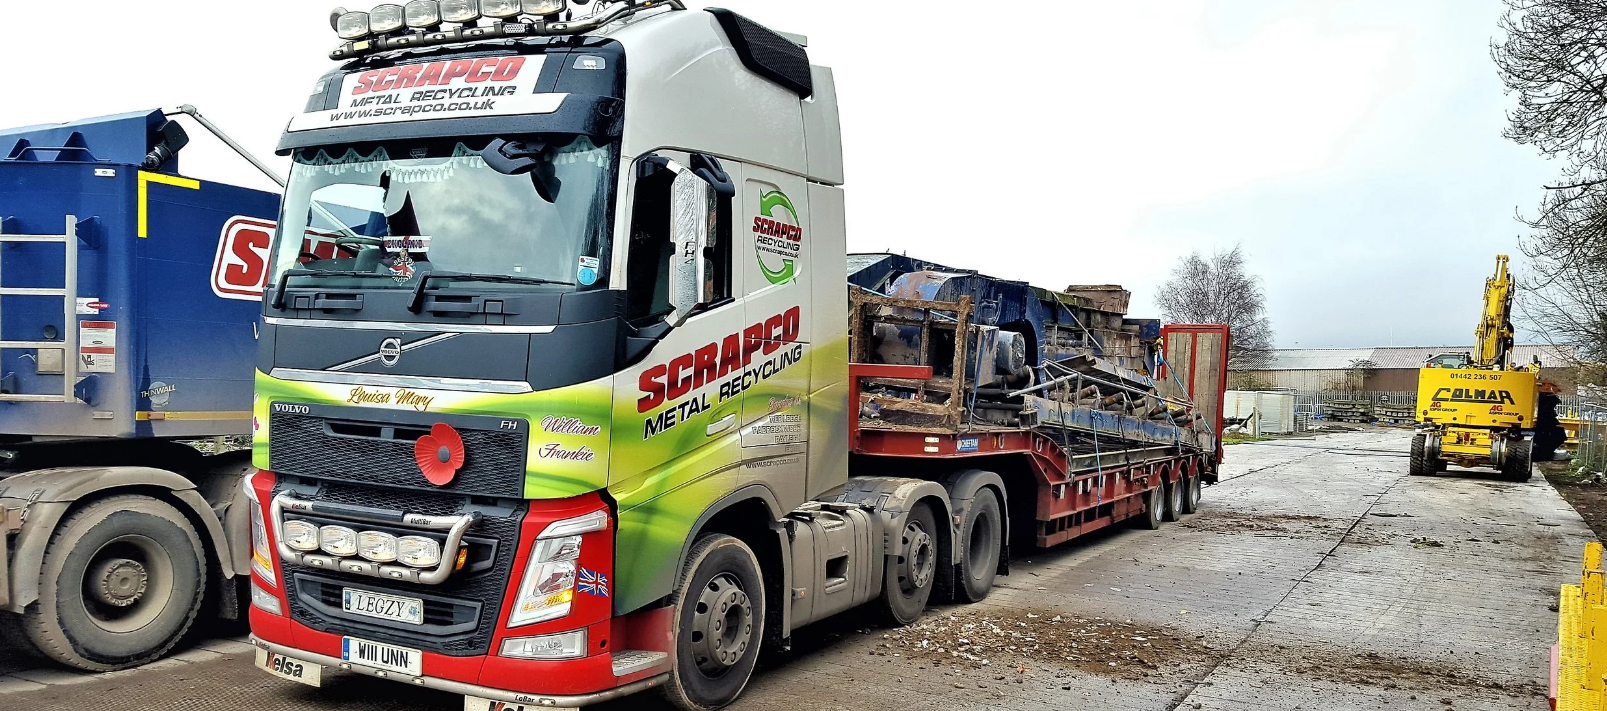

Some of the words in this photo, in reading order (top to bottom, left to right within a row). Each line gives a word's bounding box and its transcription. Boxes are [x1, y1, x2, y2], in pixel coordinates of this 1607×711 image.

[351, 57, 526, 95] SCRAPCO
[350, 93, 402, 108] METAL
[410, 86, 517, 102] RECYCLING
[330, 98, 496, 121] www.scrapco.co.uk
[752, 216, 802, 242] SCRAPCO
[756, 235, 800, 251] RECYCLING
[637, 305, 800, 414] SCRAPCO
[347, 386, 391, 405] Louisa
[395, 388, 434, 412] Mary
[643, 393, 711, 441] METAL
[718, 344, 802, 404] RECYCLING
[1431, 387, 1515, 405] COLMAR
[274, 403, 310, 414] VOLVO
[500, 420, 517, 430] FH
[541, 415, 601, 436] William
[539, 443, 595, 462] Frankie
[356, 594, 405, 618] LEGZY
[266, 651, 304, 678] Kelsa
[381, 646, 408, 668] UNN
[515, 694, 535, 703] LoBar
